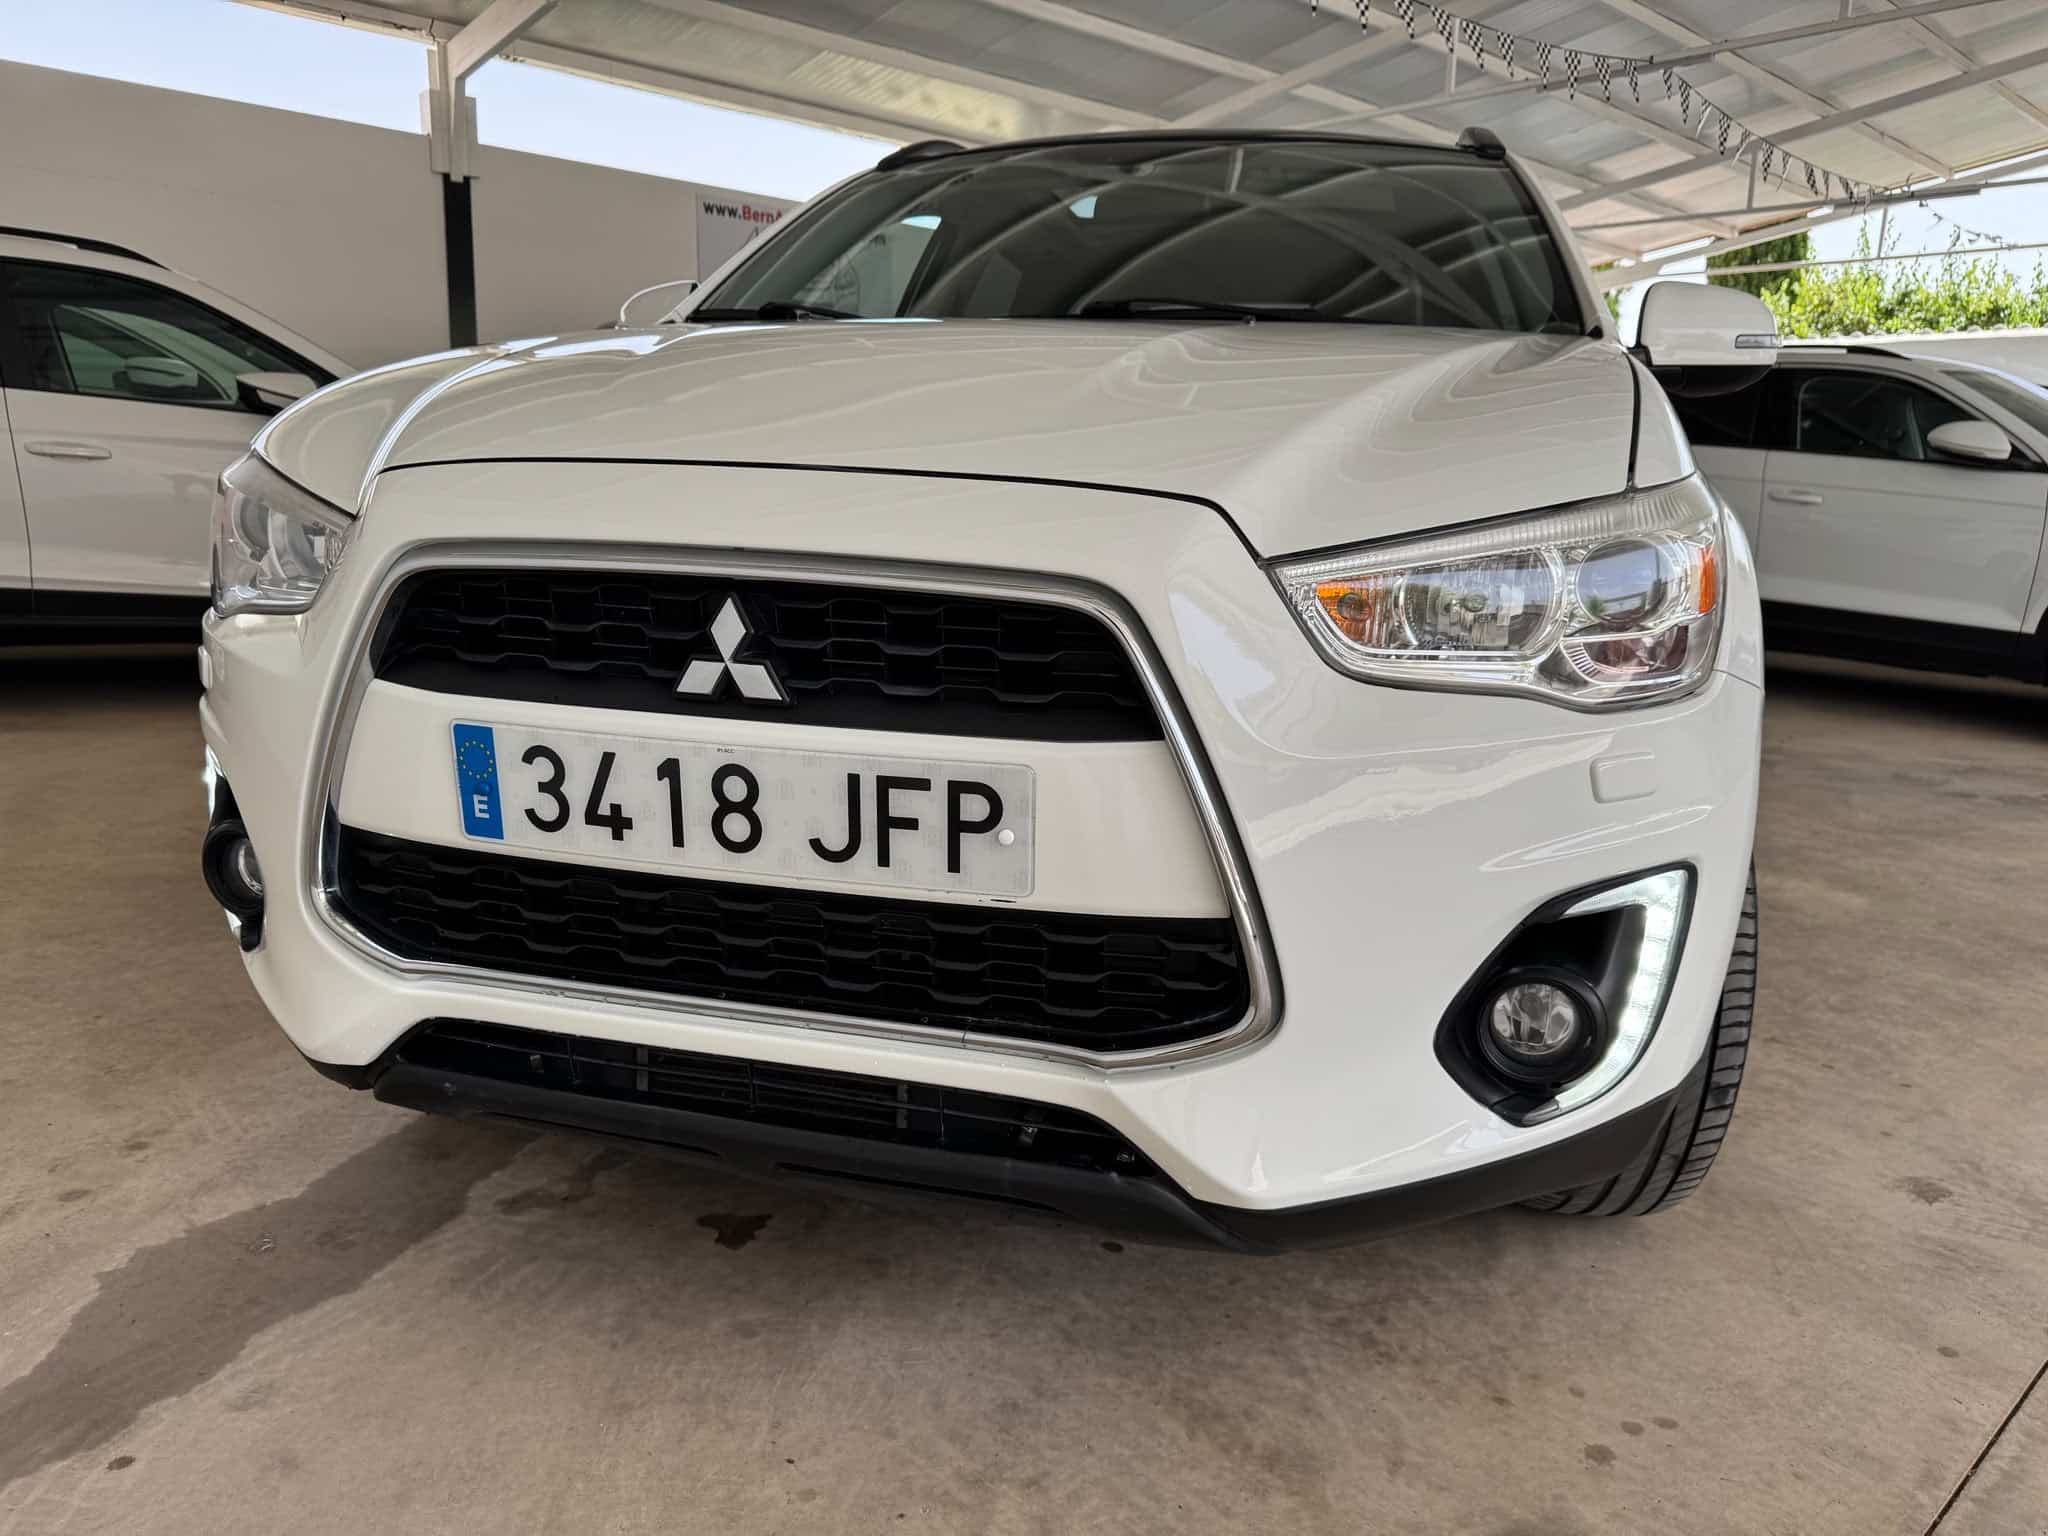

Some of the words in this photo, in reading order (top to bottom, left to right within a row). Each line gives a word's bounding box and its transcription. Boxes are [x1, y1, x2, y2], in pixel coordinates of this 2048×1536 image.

[473, 794, 490, 818] E
[521, 744, 763, 854] 3418
[808, 772, 1004, 874] JFP
